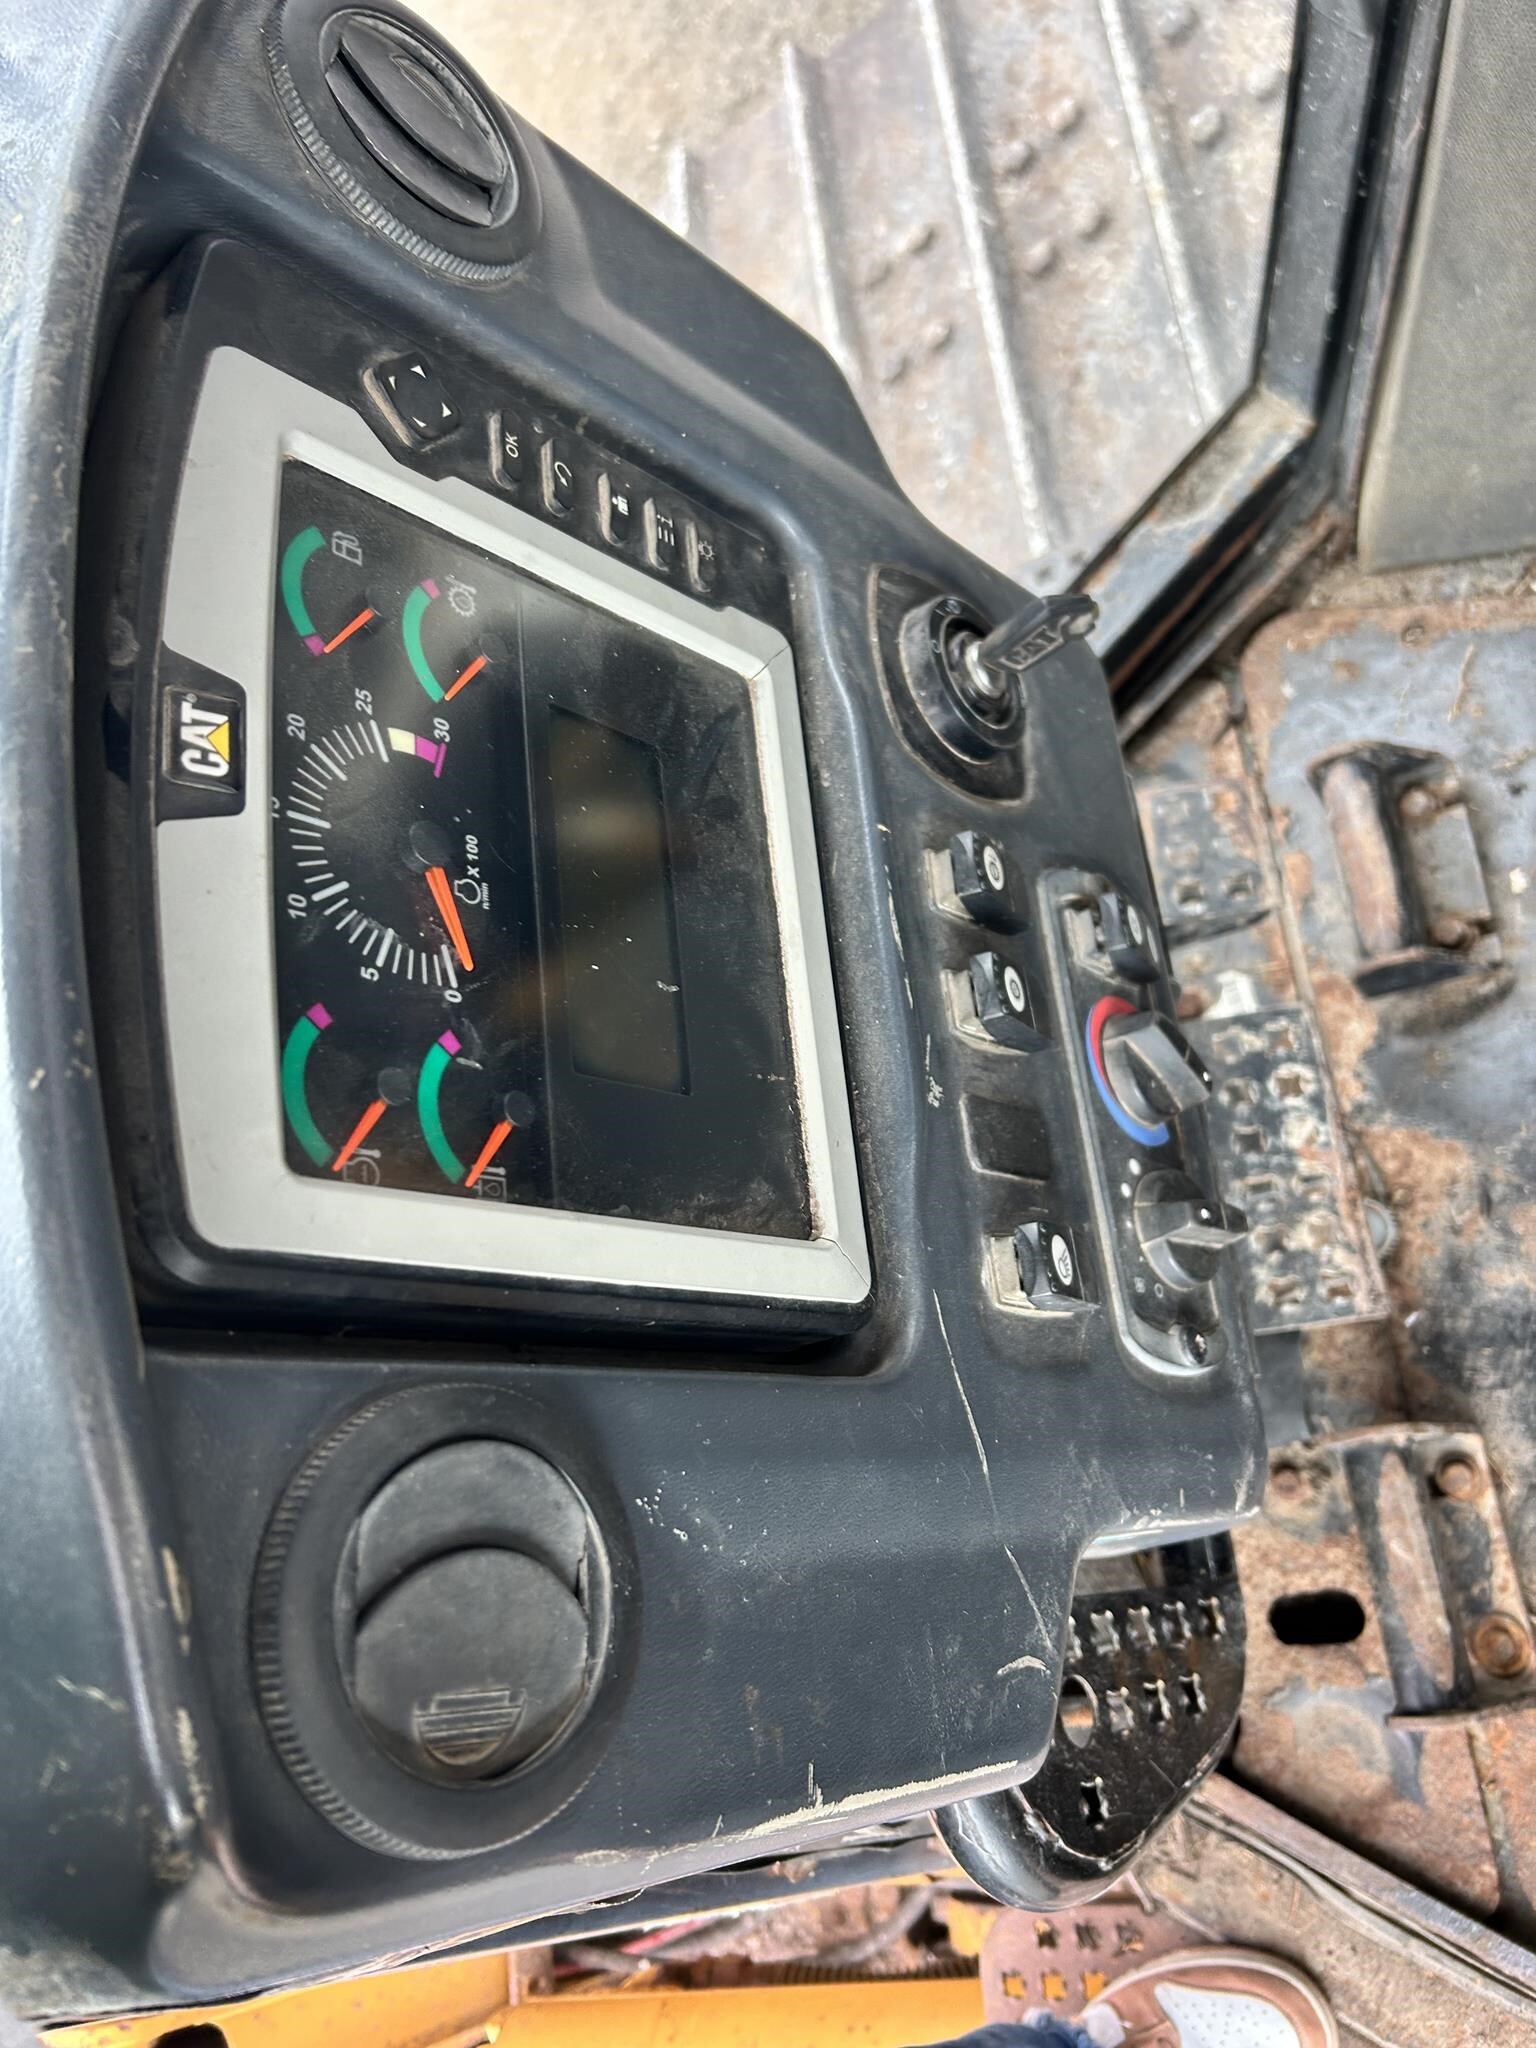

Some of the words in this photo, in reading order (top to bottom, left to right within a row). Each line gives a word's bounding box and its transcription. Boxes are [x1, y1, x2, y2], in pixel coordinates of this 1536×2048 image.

[505, 431, 519, 458] OK
[355, 687, 373, 716] 25
[180, 700, 230, 777] CAT
[287, 713, 306, 741] 20
[433, 717, 451, 742] 30
[465, 834, 479, 861] 100
[287, 893, 307, 919] 10
[360, 966, 380, 982] 5
[444, 989, 463, 1003] 0
